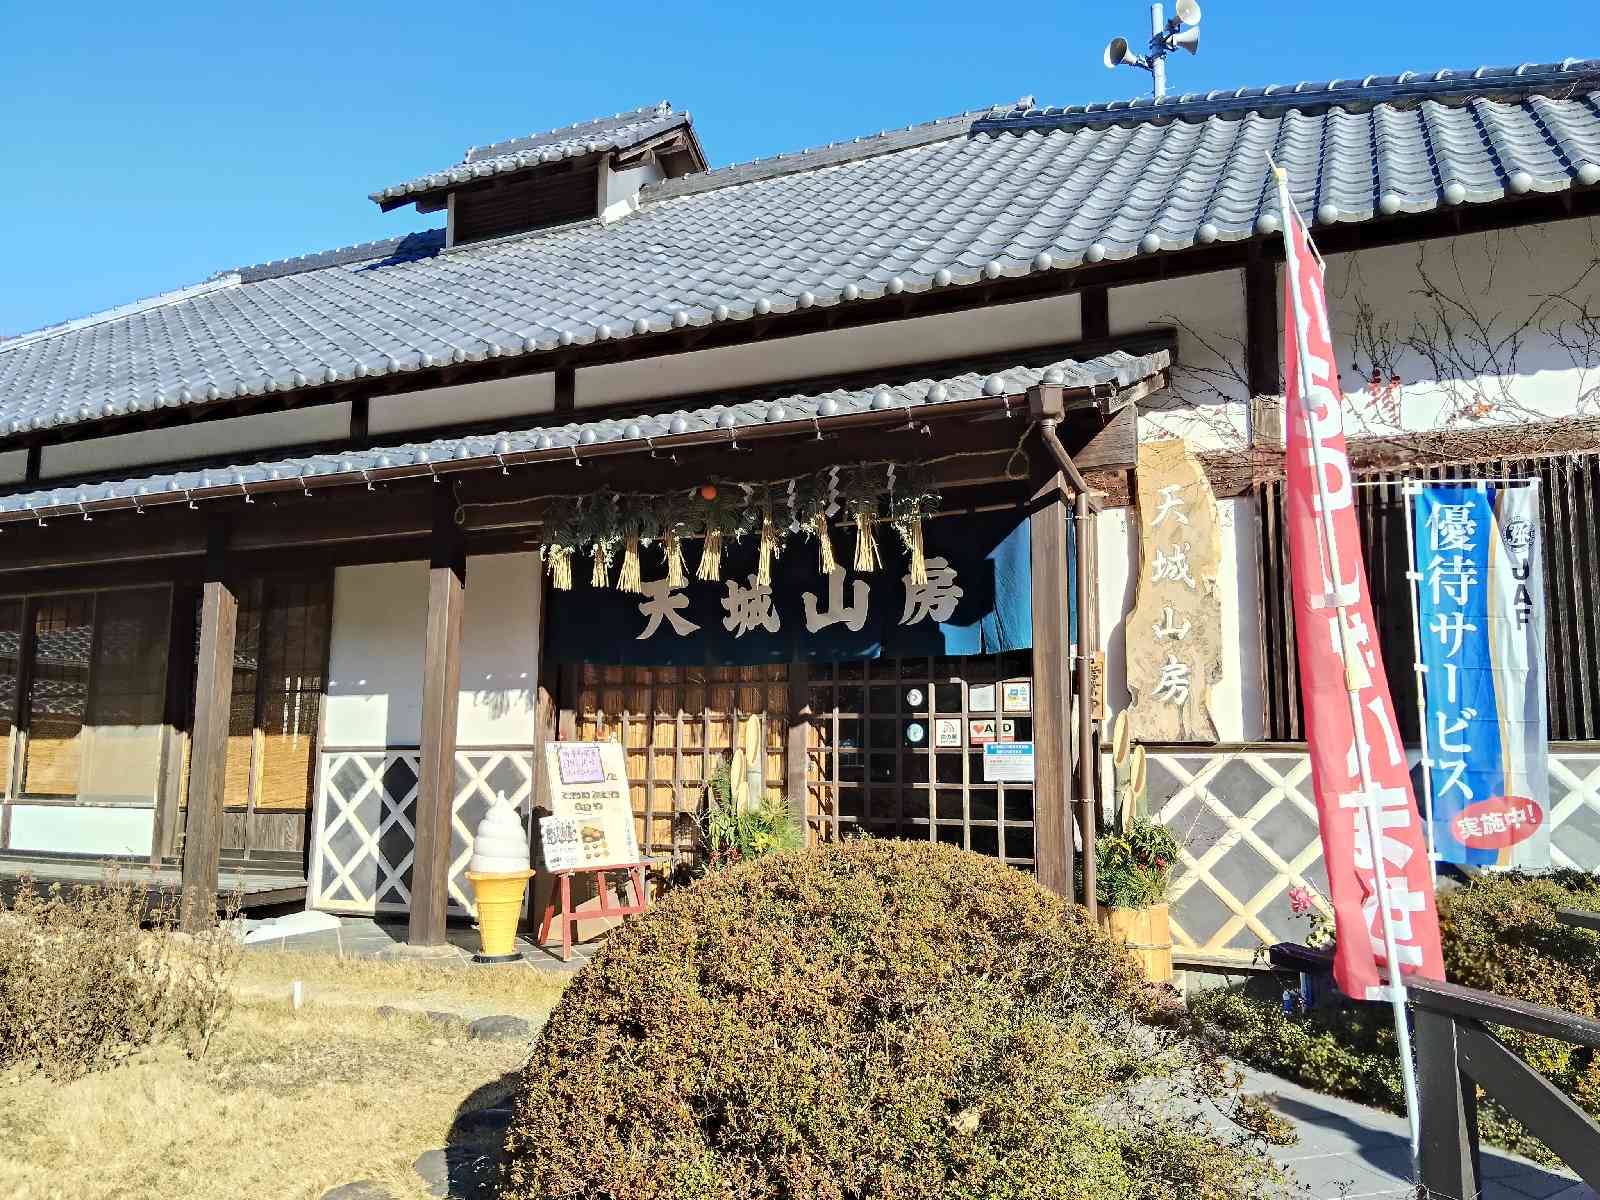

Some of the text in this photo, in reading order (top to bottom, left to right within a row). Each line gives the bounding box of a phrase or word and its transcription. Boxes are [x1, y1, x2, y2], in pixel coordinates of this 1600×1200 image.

[636, 557, 964, 639] 天城山房
[1150, 484, 1196, 706] 天城山房
[1427, 500, 1479, 801] 優待サービス
[1511, 558, 1533, 631] JAF
